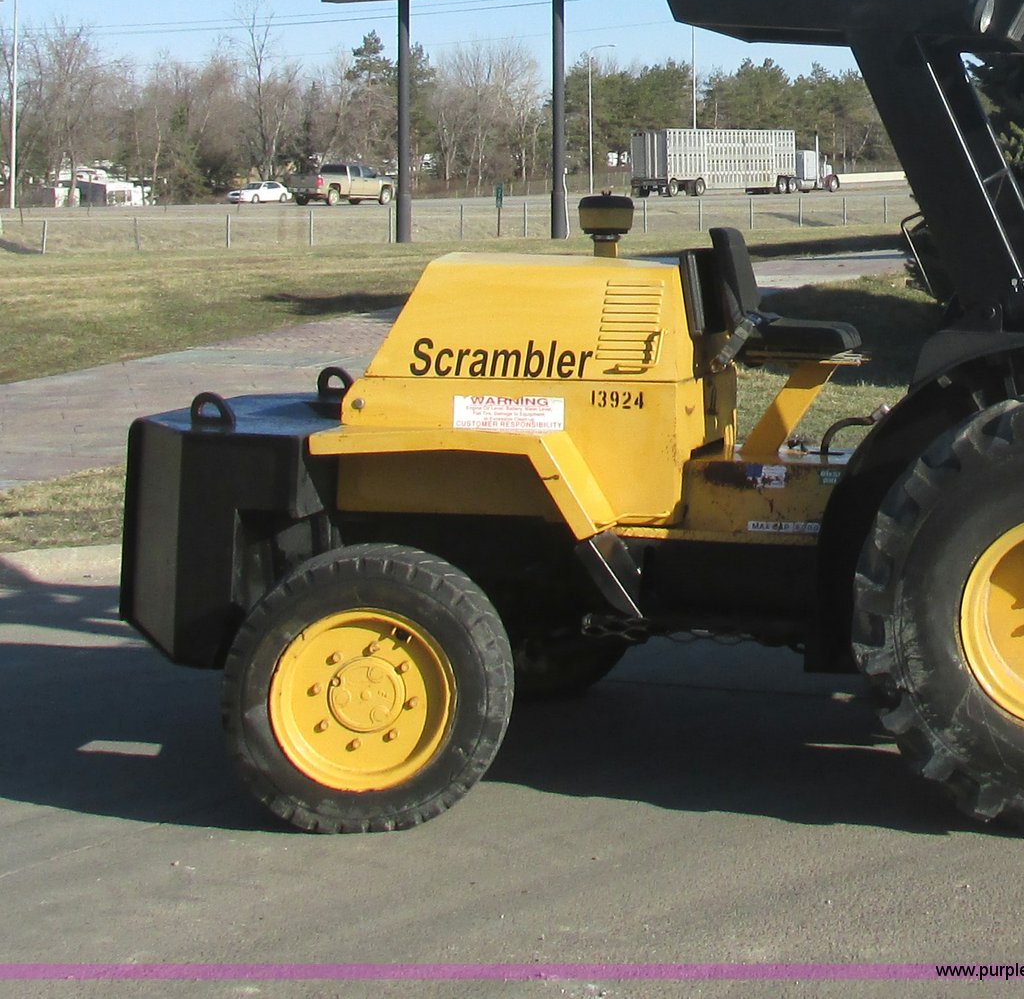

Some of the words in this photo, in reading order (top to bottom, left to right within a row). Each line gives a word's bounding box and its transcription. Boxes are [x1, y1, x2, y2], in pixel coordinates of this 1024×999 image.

[409, 337, 593, 378] Scrambler
[471, 396, 549, 406] WARNING
[591, 390, 644, 409] 13924
